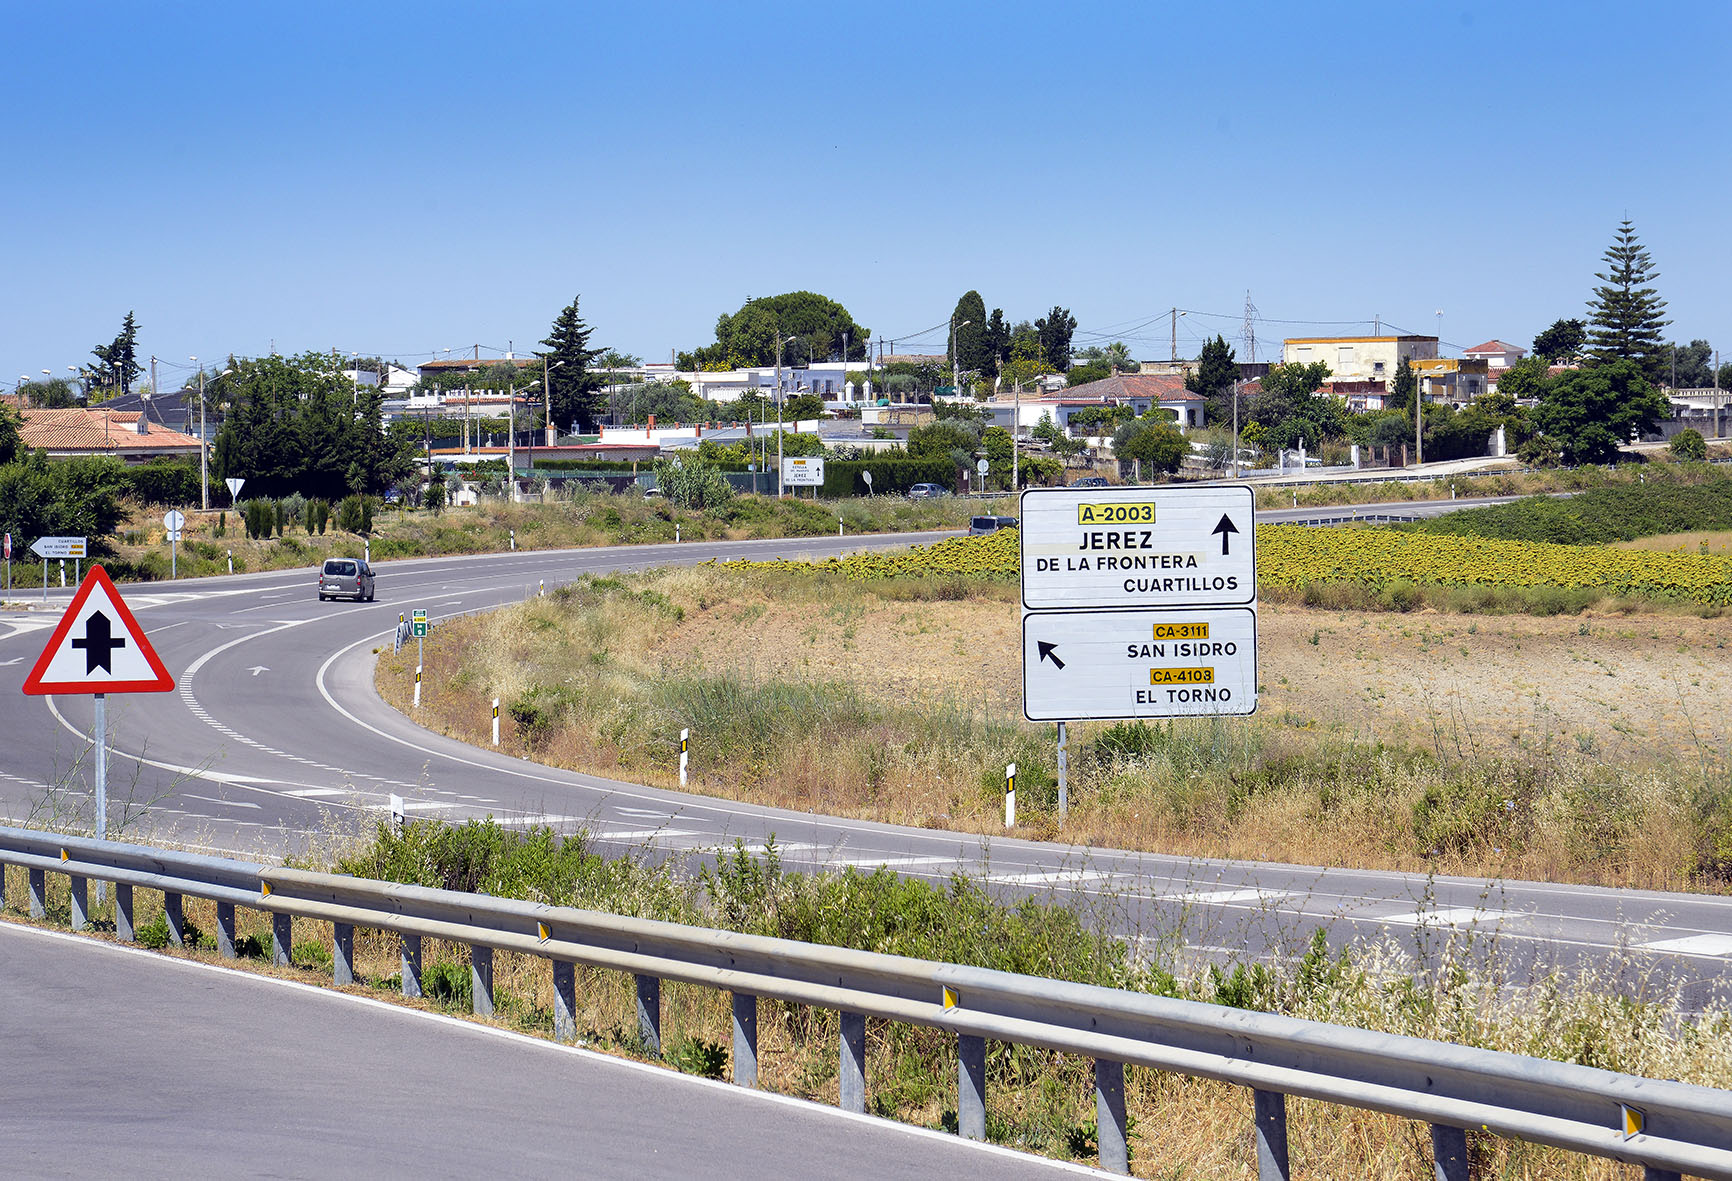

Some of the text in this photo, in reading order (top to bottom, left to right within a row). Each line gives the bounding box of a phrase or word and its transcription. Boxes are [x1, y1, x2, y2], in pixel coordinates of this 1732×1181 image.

[1082, 506, 1152, 522] A-2003
[1079, 531, 1152, 550] JEREZ
[1036, 555, 1198, 572] DE LA FRONTERA
[1124, 576, 1238, 592] CUARTILLOS
[1156, 626, 1207, 638] CA-3111
[1127, 642, 1237, 658] SAN ISIDRO
[1136, 688, 1231, 704] EL TORNO
